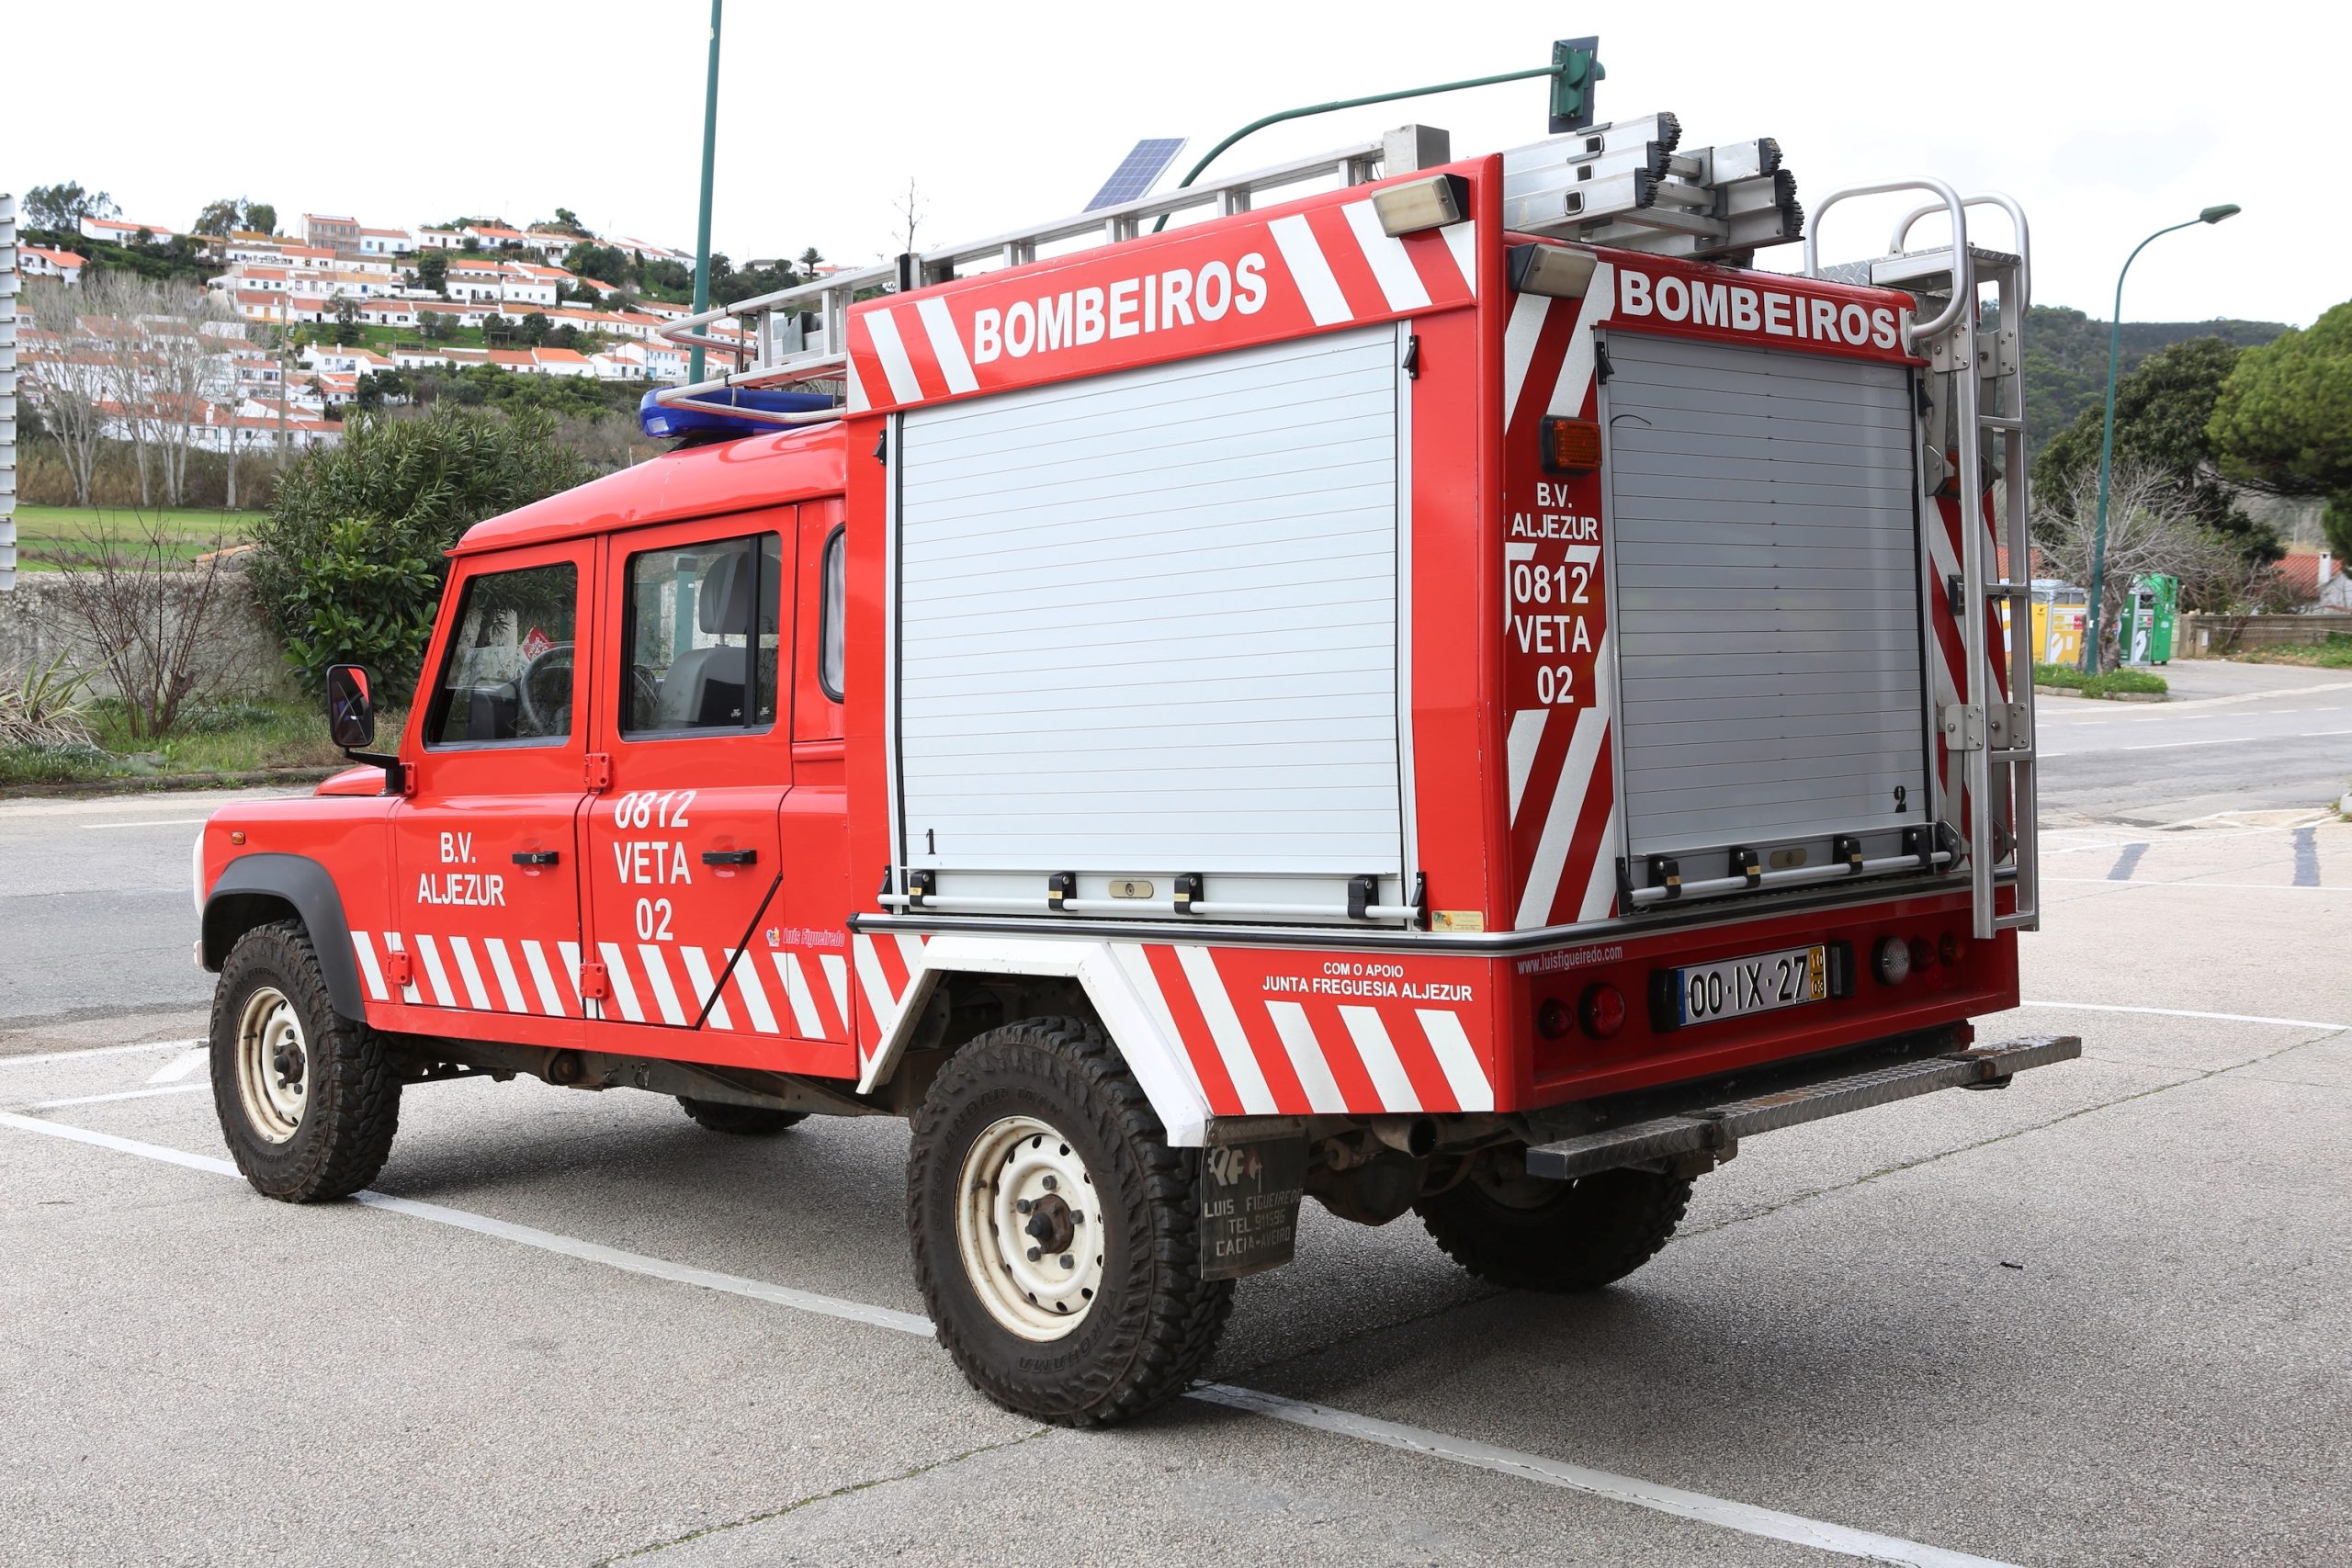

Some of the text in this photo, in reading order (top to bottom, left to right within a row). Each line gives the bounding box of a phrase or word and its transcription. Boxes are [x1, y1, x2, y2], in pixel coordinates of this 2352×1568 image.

[974, 253, 1267, 366] BOMBEIROS
[1620, 269, 1896, 349] BOMBEIROS
[1537, 482, 1573, 508] B.V.
[1511, 513, 1599, 540] ALJEZUR
[1514, 564, 1589, 604] 0812
[1514, 615, 1592, 653] VETA
[1537, 665, 1574, 705] 02
[614, 790, 697, 829] 0812
[440, 831, 477, 863] B.V.
[613, 840, 692, 885] VETA
[417, 873, 506, 907] ALJEZUR
[635, 897, 674, 942] 02
[801, 929, 845, 948] Figueiredo
[1323, 962, 1404, 978] COM O APOIO
[1517, 945, 1623, 975] www.luisfigueiredo.com
[1262, 976, 1474, 1002] JUNTA FREGUESIA ALJEZUR
[1204, 1199, 1235, 1218] LUIS
